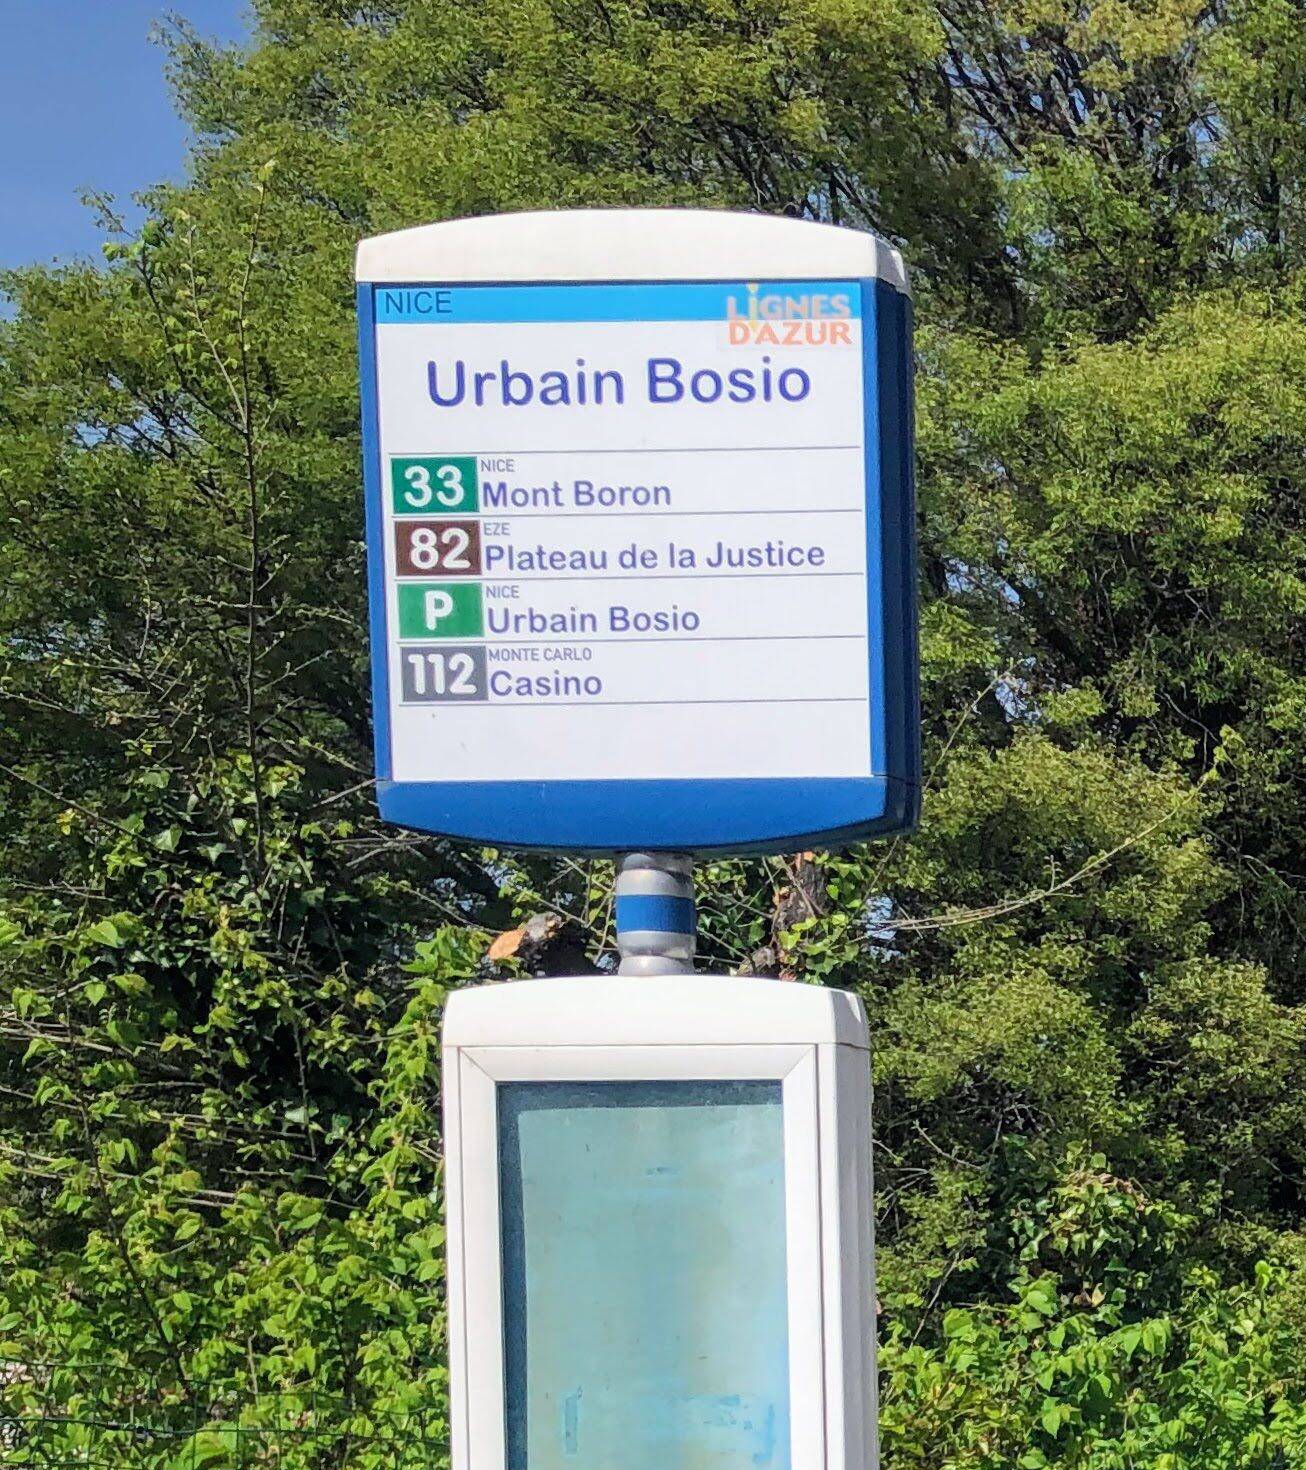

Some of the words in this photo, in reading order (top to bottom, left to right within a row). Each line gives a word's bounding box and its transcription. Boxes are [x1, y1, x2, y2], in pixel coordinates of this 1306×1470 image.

[384, 291, 453, 315] NICE
[426, 358, 625, 407] Urbain
[646, 355, 811, 404] Bosio
[480, 459, 515, 473] NICE
[403, 465, 465, 508] 33
[482, 481, 565, 508] Mont
[573, 480, 671, 507] Boron
[483, 522, 510, 536] EZE
[409, 528, 470, 570] 82
[484, 543, 608, 571] Plateau
[618, 543, 658, 569] de
[668, 543, 696, 568] la
[705, 540, 826, 568] Justice
[485, 585, 519, 599] NICE
[424, 591, 453, 631] P
[487, 605, 598, 634] Urbain
[608, 604, 700, 632] Bosio
[488, 648, 539, 662] MONTE
[543, 647, 592, 661] CARLO
[408, 653, 477, 695] 112
[489, 670, 602, 698] Casino
